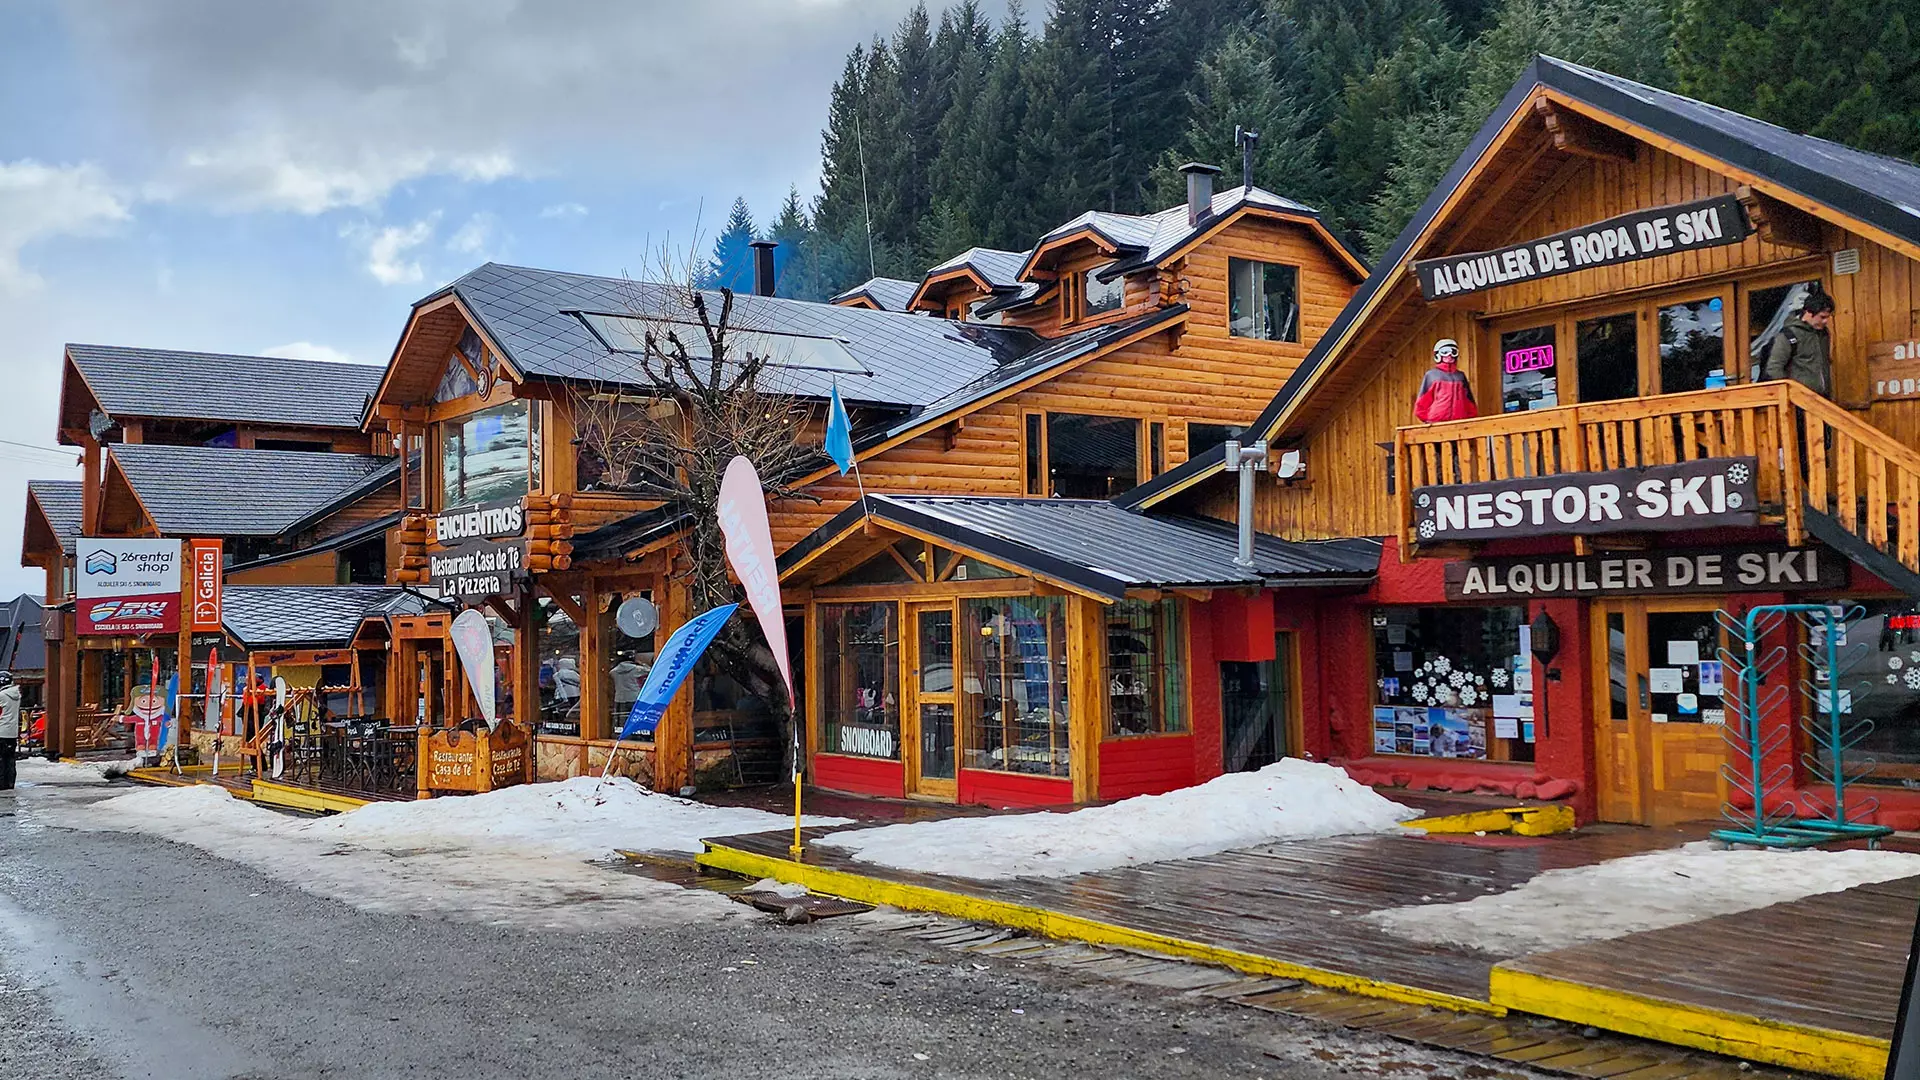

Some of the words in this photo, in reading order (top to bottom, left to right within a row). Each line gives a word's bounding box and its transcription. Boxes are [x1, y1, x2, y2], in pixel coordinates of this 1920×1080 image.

[1432, 247, 1535, 296] ALQUILER
[1535, 239, 1570, 274] DE
[1570, 226, 1636, 267] ROPA
[1636, 216, 1675, 252] DE
[1674, 206, 1723, 245] SKI
[1509, 348, 1551, 371] OPEN
[1893, 341, 1920, 360] al
[1435, 483, 1625, 532] NESTOR
[1635, 474, 1727, 519] SKI
[436, 505, 522, 541] ENCUENTROS
[120, 551, 174, 562] 26rental
[136, 562, 170, 574] shop
[431, 553, 475, 577] Restaurante
[475, 550, 496, 572] Casa
[496, 548, 507, 571] de
[507, 546, 520, 570] Té
[199, 552, 214, 599] Galicia
[1462, 558, 1654, 596] ALQUILER
[1667, 554, 1723, 587] DE
[1737, 549, 1819, 587] SKI
[443, 578, 456, 597] La
[841, 725, 892, 757] SNOWBOARD
[433, 750, 474, 763] Restaurante
[435, 763, 452, 776] Casa
[452, 764, 462, 776] de
[463, 764, 472, 776] Té
